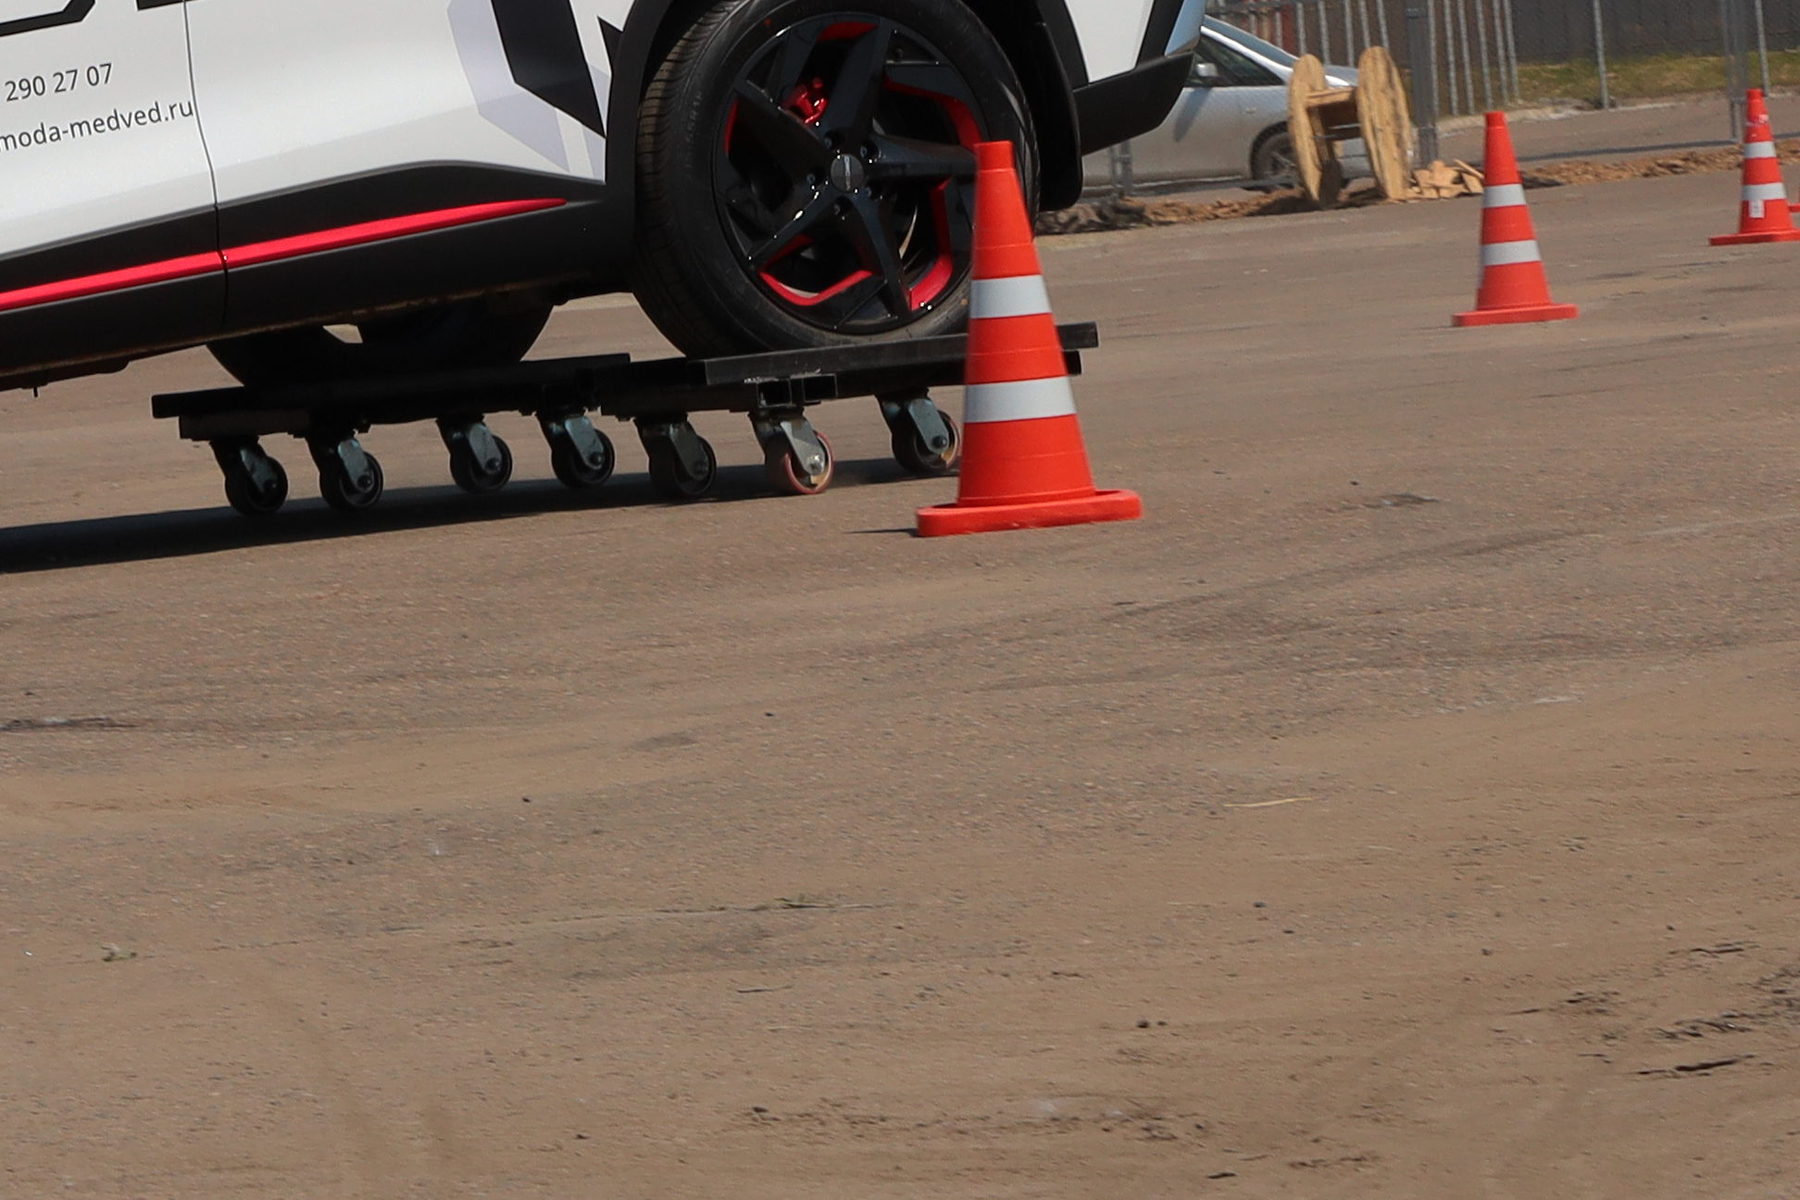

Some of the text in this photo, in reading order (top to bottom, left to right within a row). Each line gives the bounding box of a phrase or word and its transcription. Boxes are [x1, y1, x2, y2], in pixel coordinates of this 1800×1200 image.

[4, 75, 47, 103] 290
[52, 68, 79, 94] 27
[86, 62, 113, 87] 07
